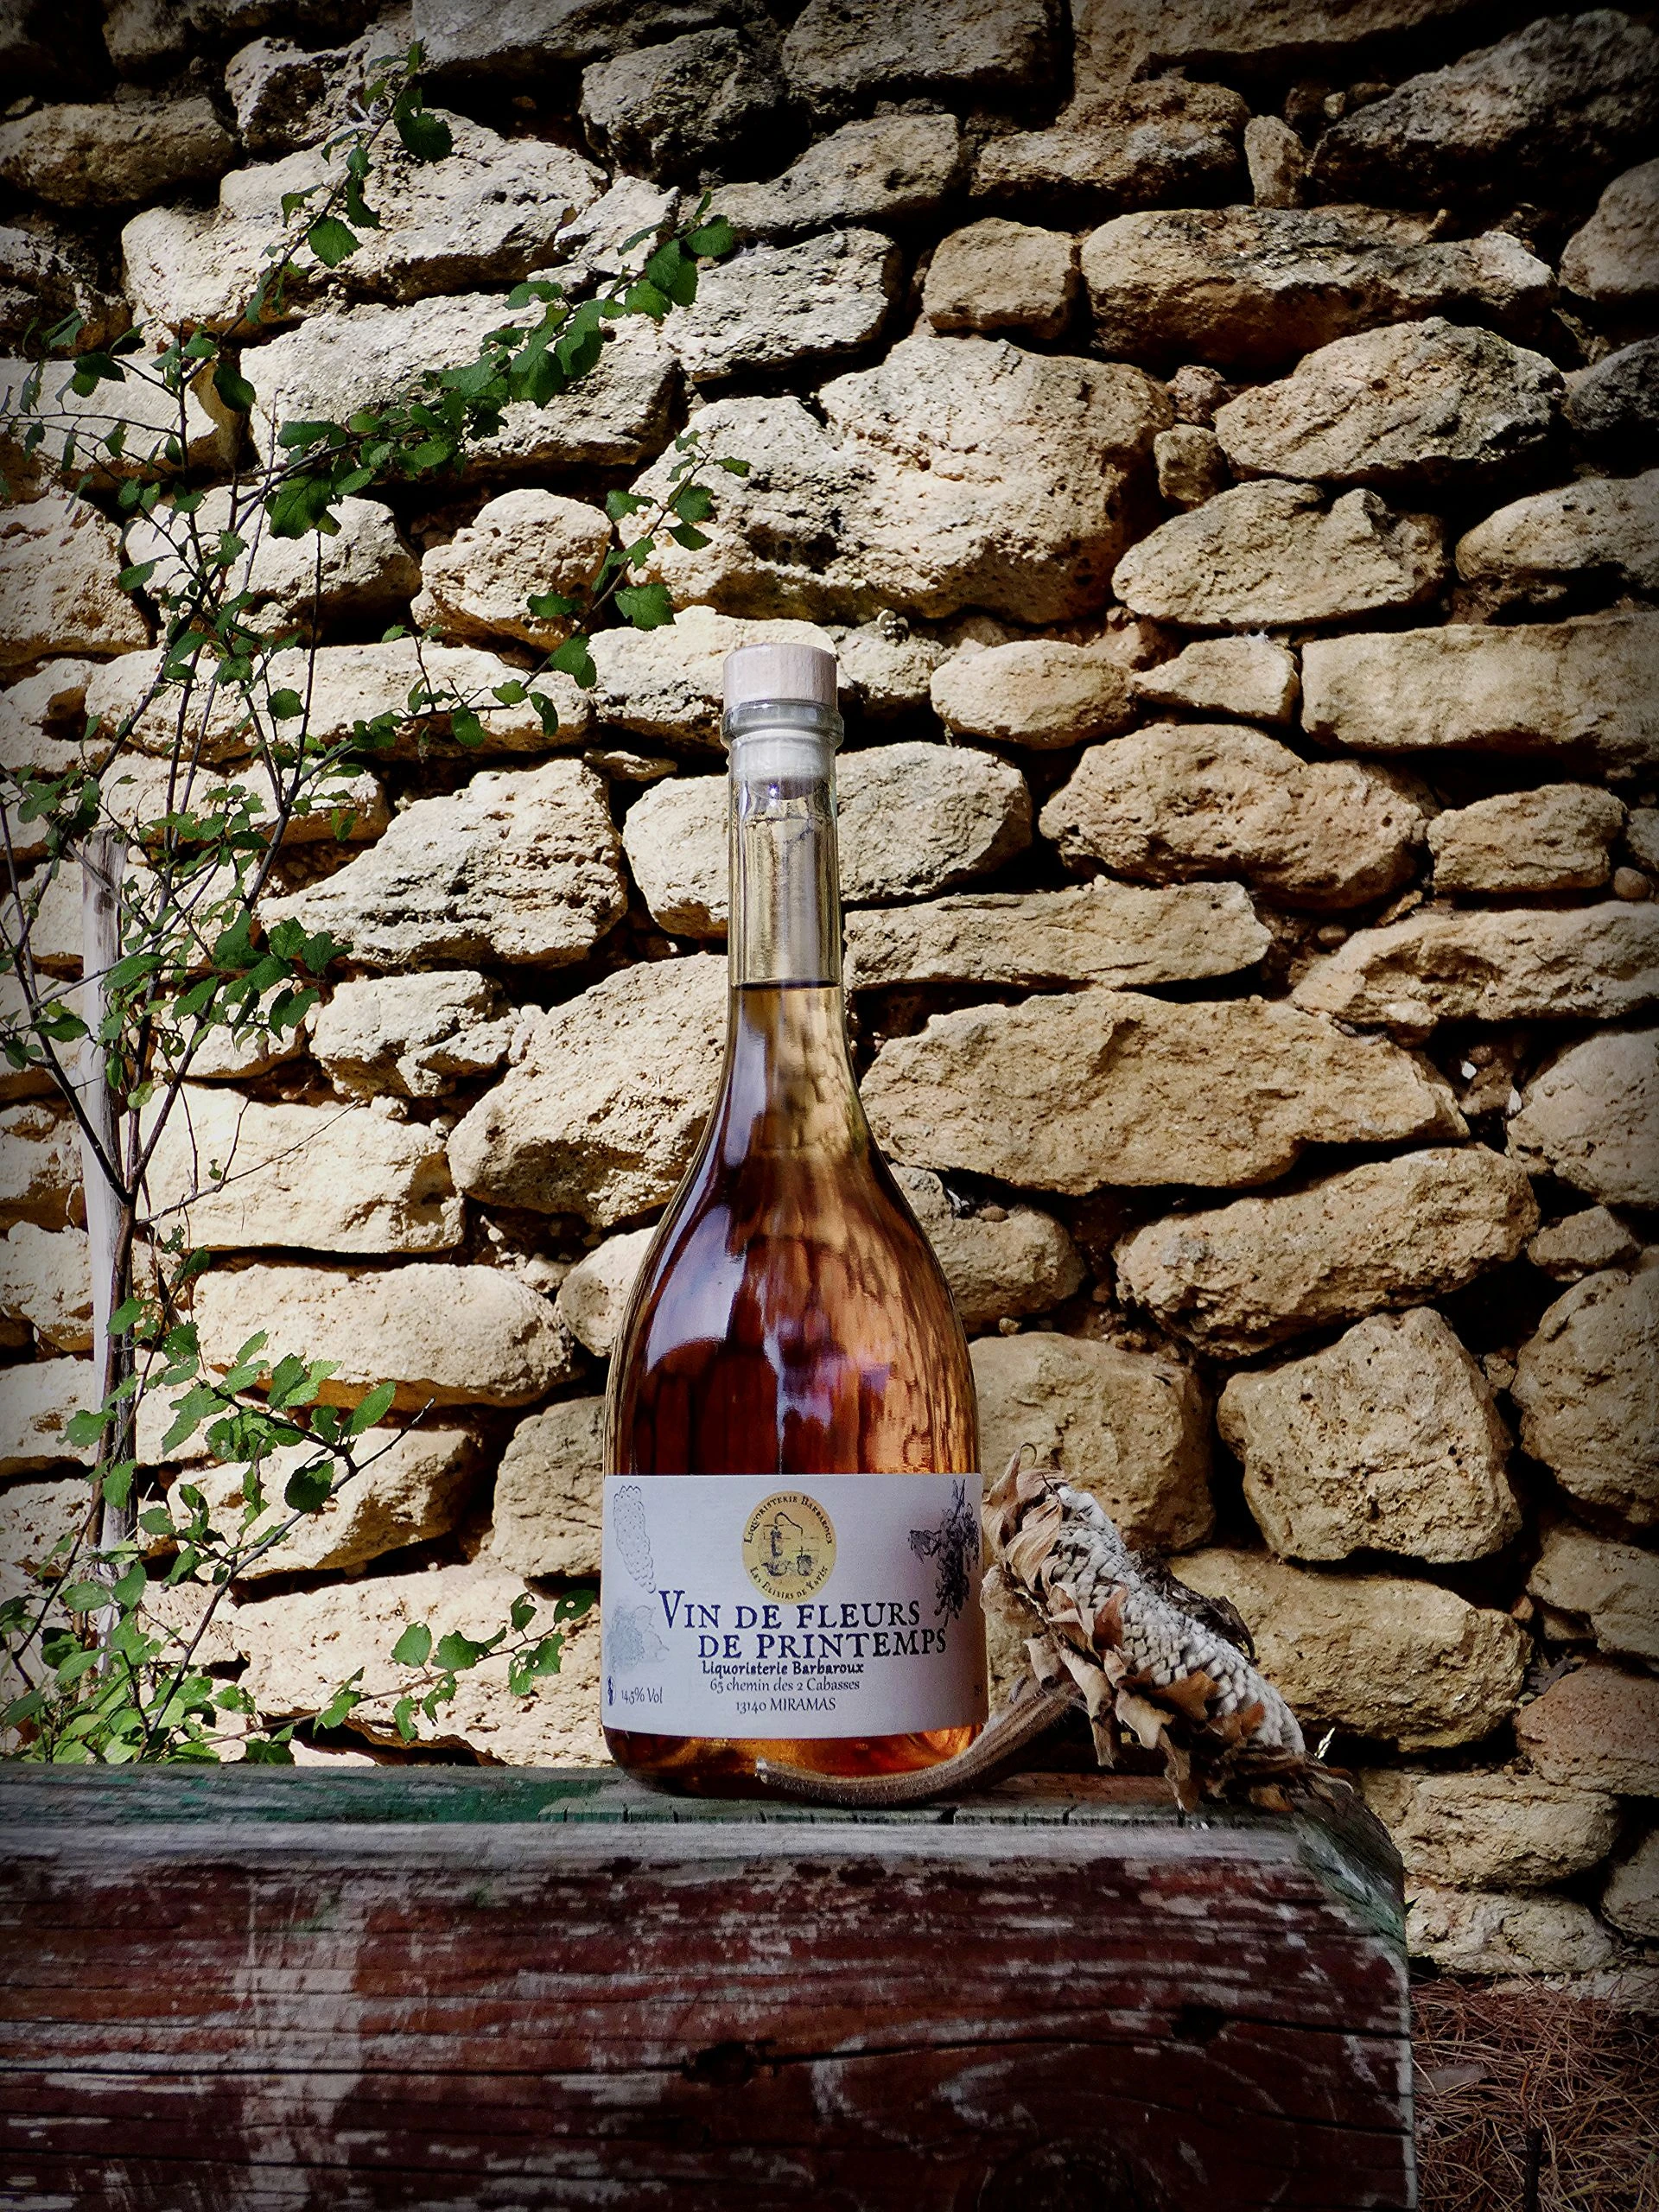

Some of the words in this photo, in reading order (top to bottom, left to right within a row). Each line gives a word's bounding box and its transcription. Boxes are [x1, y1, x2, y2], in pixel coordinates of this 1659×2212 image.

[734, 1605, 783, 1630] DE
[796, 1600, 920, 1630] FLEURS
[697, 1634, 743, 1659] DE
[756, 1627, 947, 1660] PRINTEMPS
[702, 1660, 788, 1679] Liquoristerie
[791, 1657, 865, 1675] Barbaroux
[709, 1678, 724, 1694] 65
[727, 1676, 769, 1692] chemin
[773, 1676, 794, 1692] des
[796, 1682, 804, 1692] 2
[806, 1675, 861, 1692] Cabasses
[646, 1686, 663, 1704] Vol
[735, 1700, 767, 1714] 13140
[770, 1697, 836, 1713] MIRAMAS
